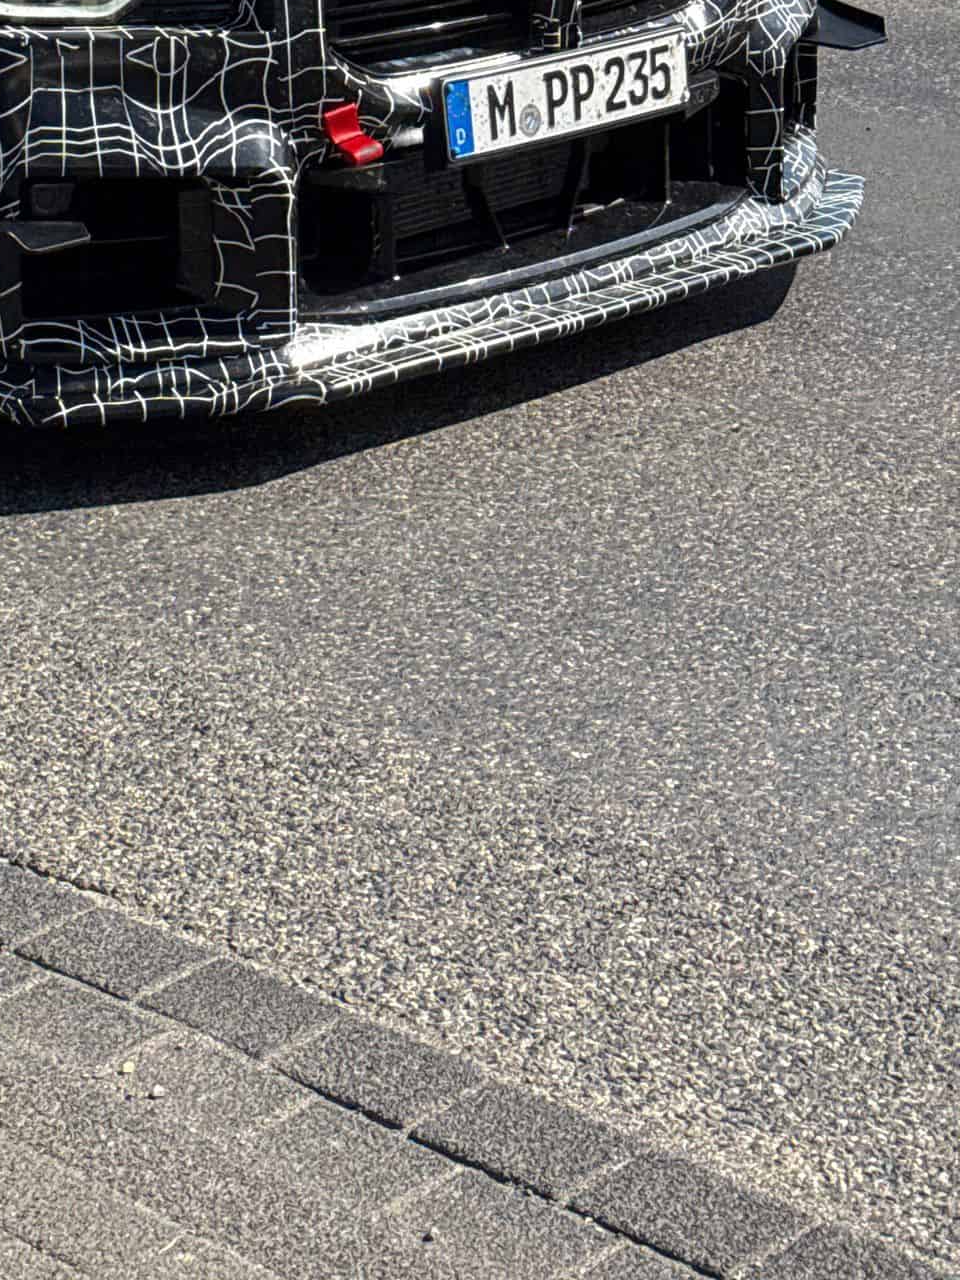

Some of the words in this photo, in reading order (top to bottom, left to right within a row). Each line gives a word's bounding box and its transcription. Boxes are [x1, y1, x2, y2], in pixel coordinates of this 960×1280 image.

[487, 80, 517, 141] M
[543, 64, 595, 129] PP
[605, 44, 672, 112] 235
